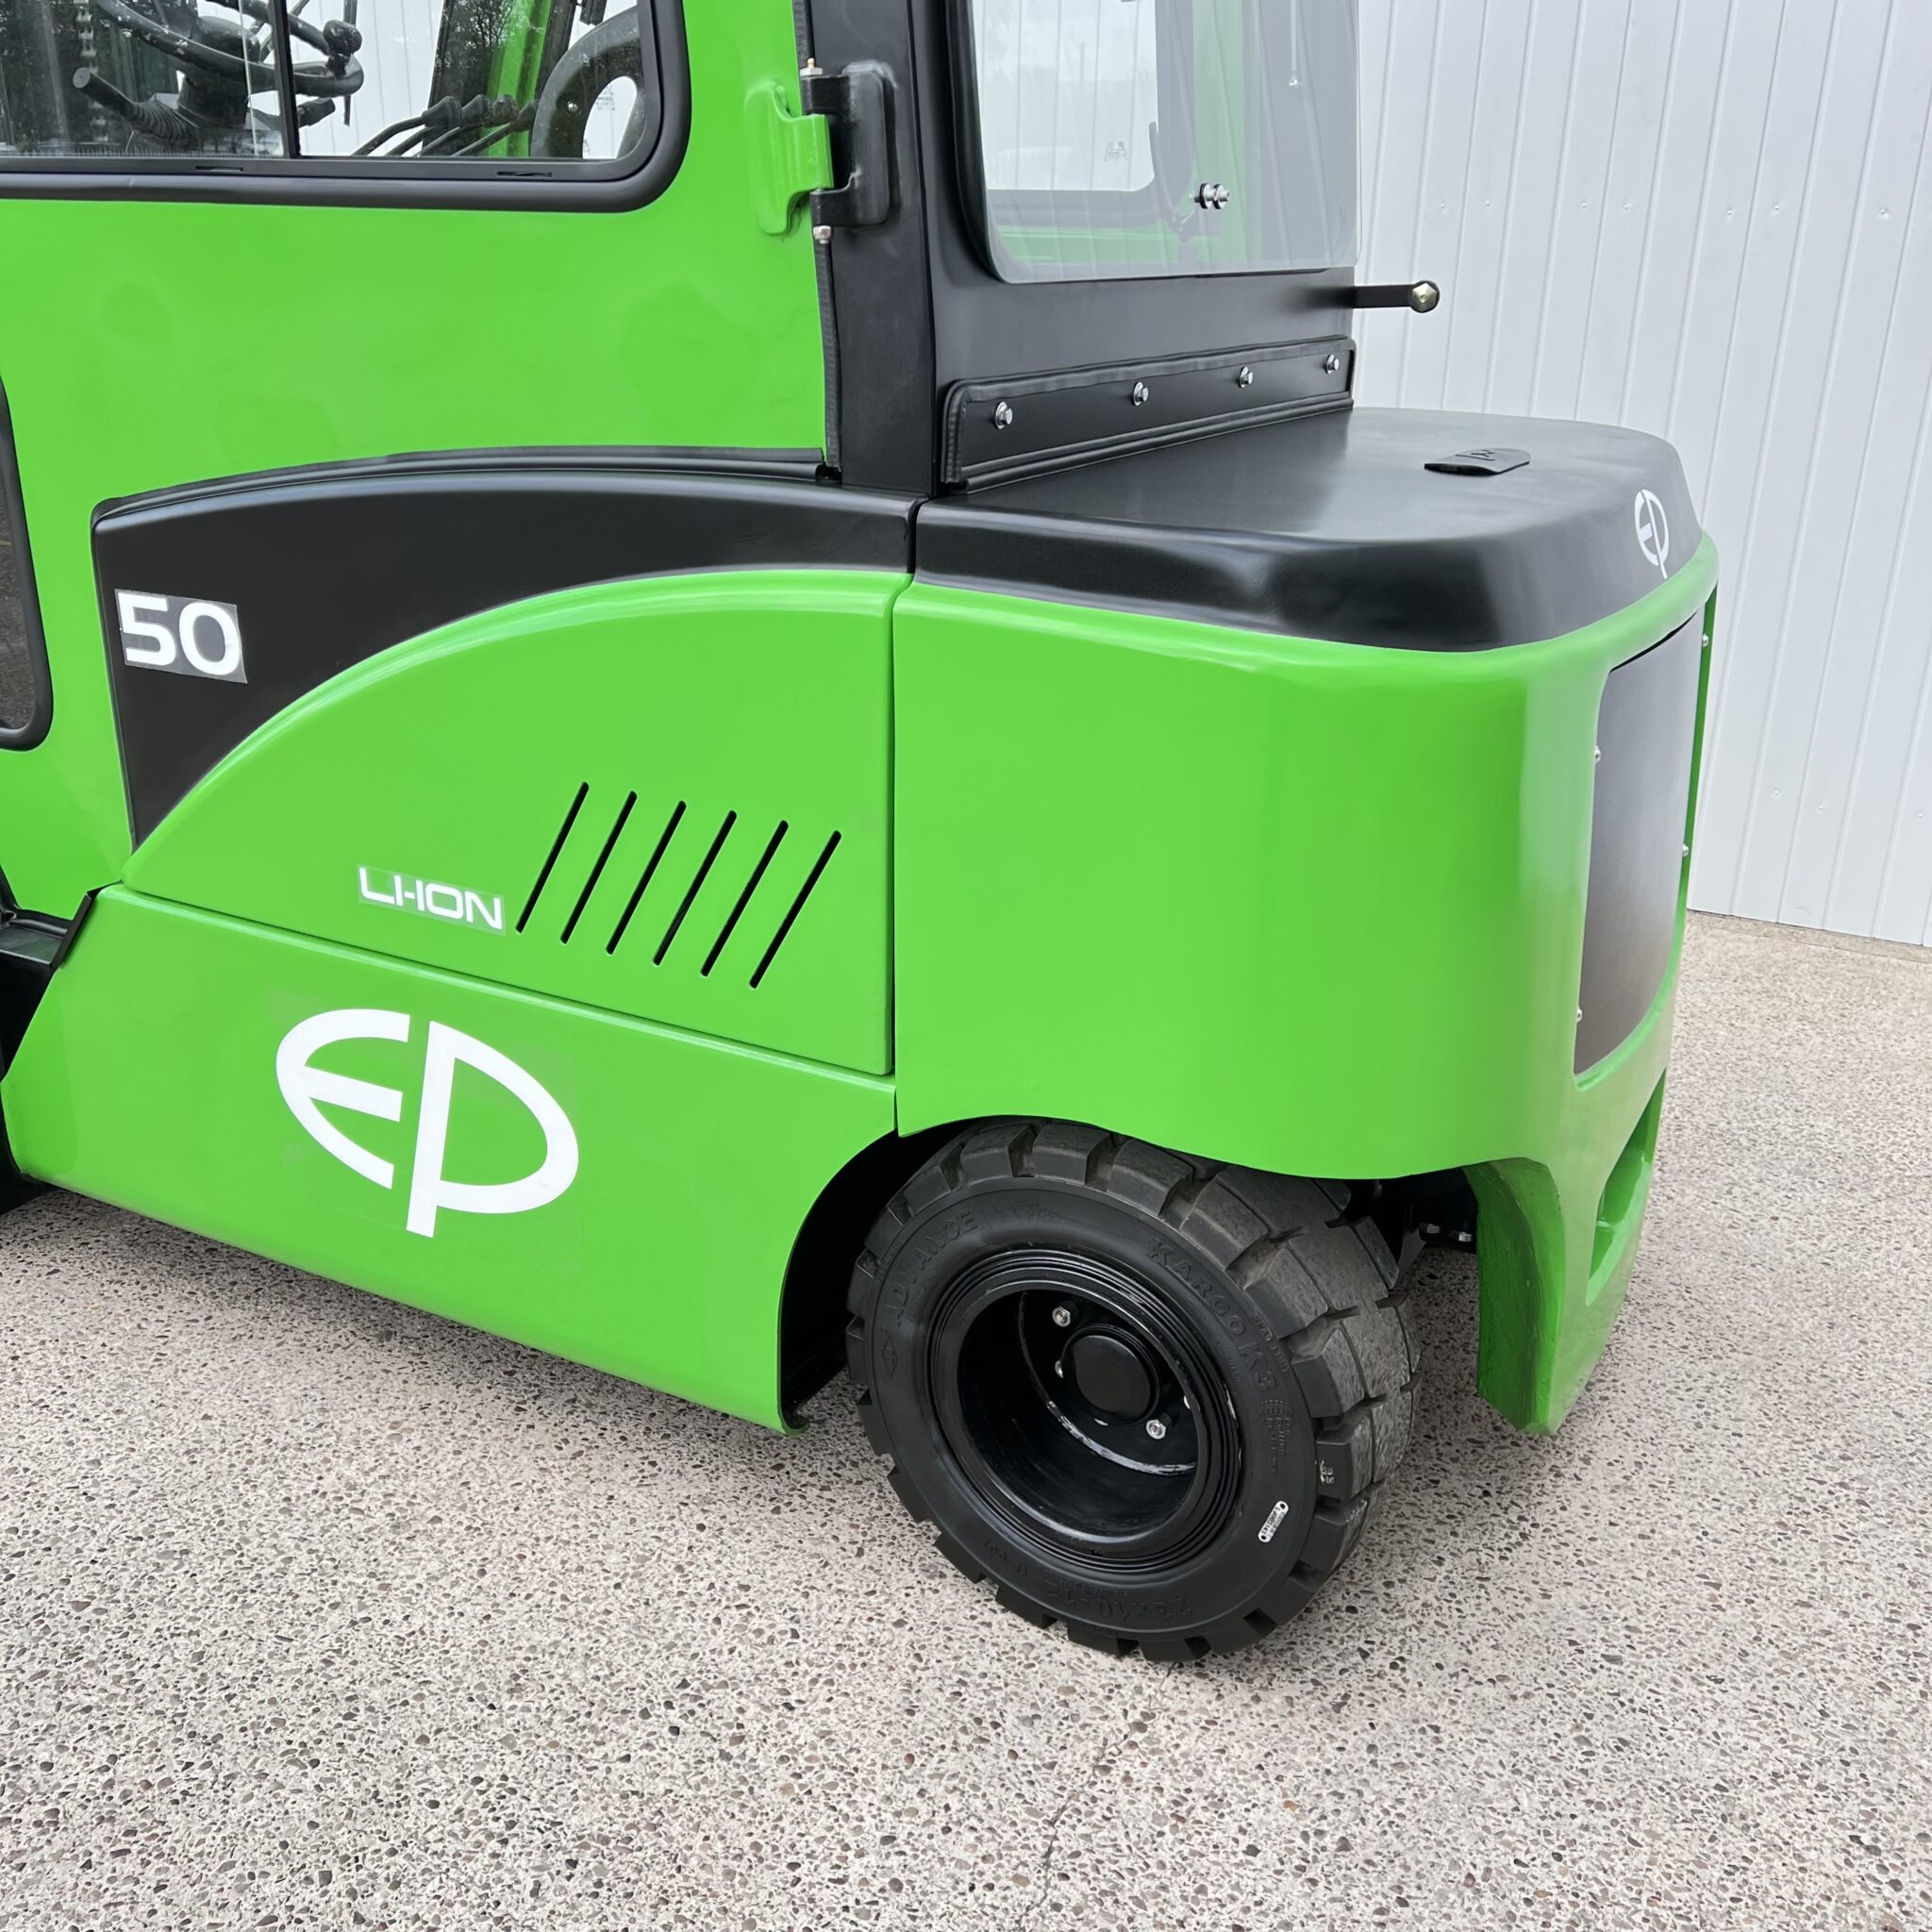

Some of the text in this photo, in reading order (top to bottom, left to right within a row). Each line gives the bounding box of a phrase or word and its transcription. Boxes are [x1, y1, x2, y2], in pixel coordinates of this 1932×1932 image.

[117, 591, 242, 675] 50
[358, 867, 504, 930] LI-ION
[275, 1008, 579, 1238] EP
[885, 1208, 978, 1327] ADVANCE
[1146, 1237, 1246, 1337] KARGO
